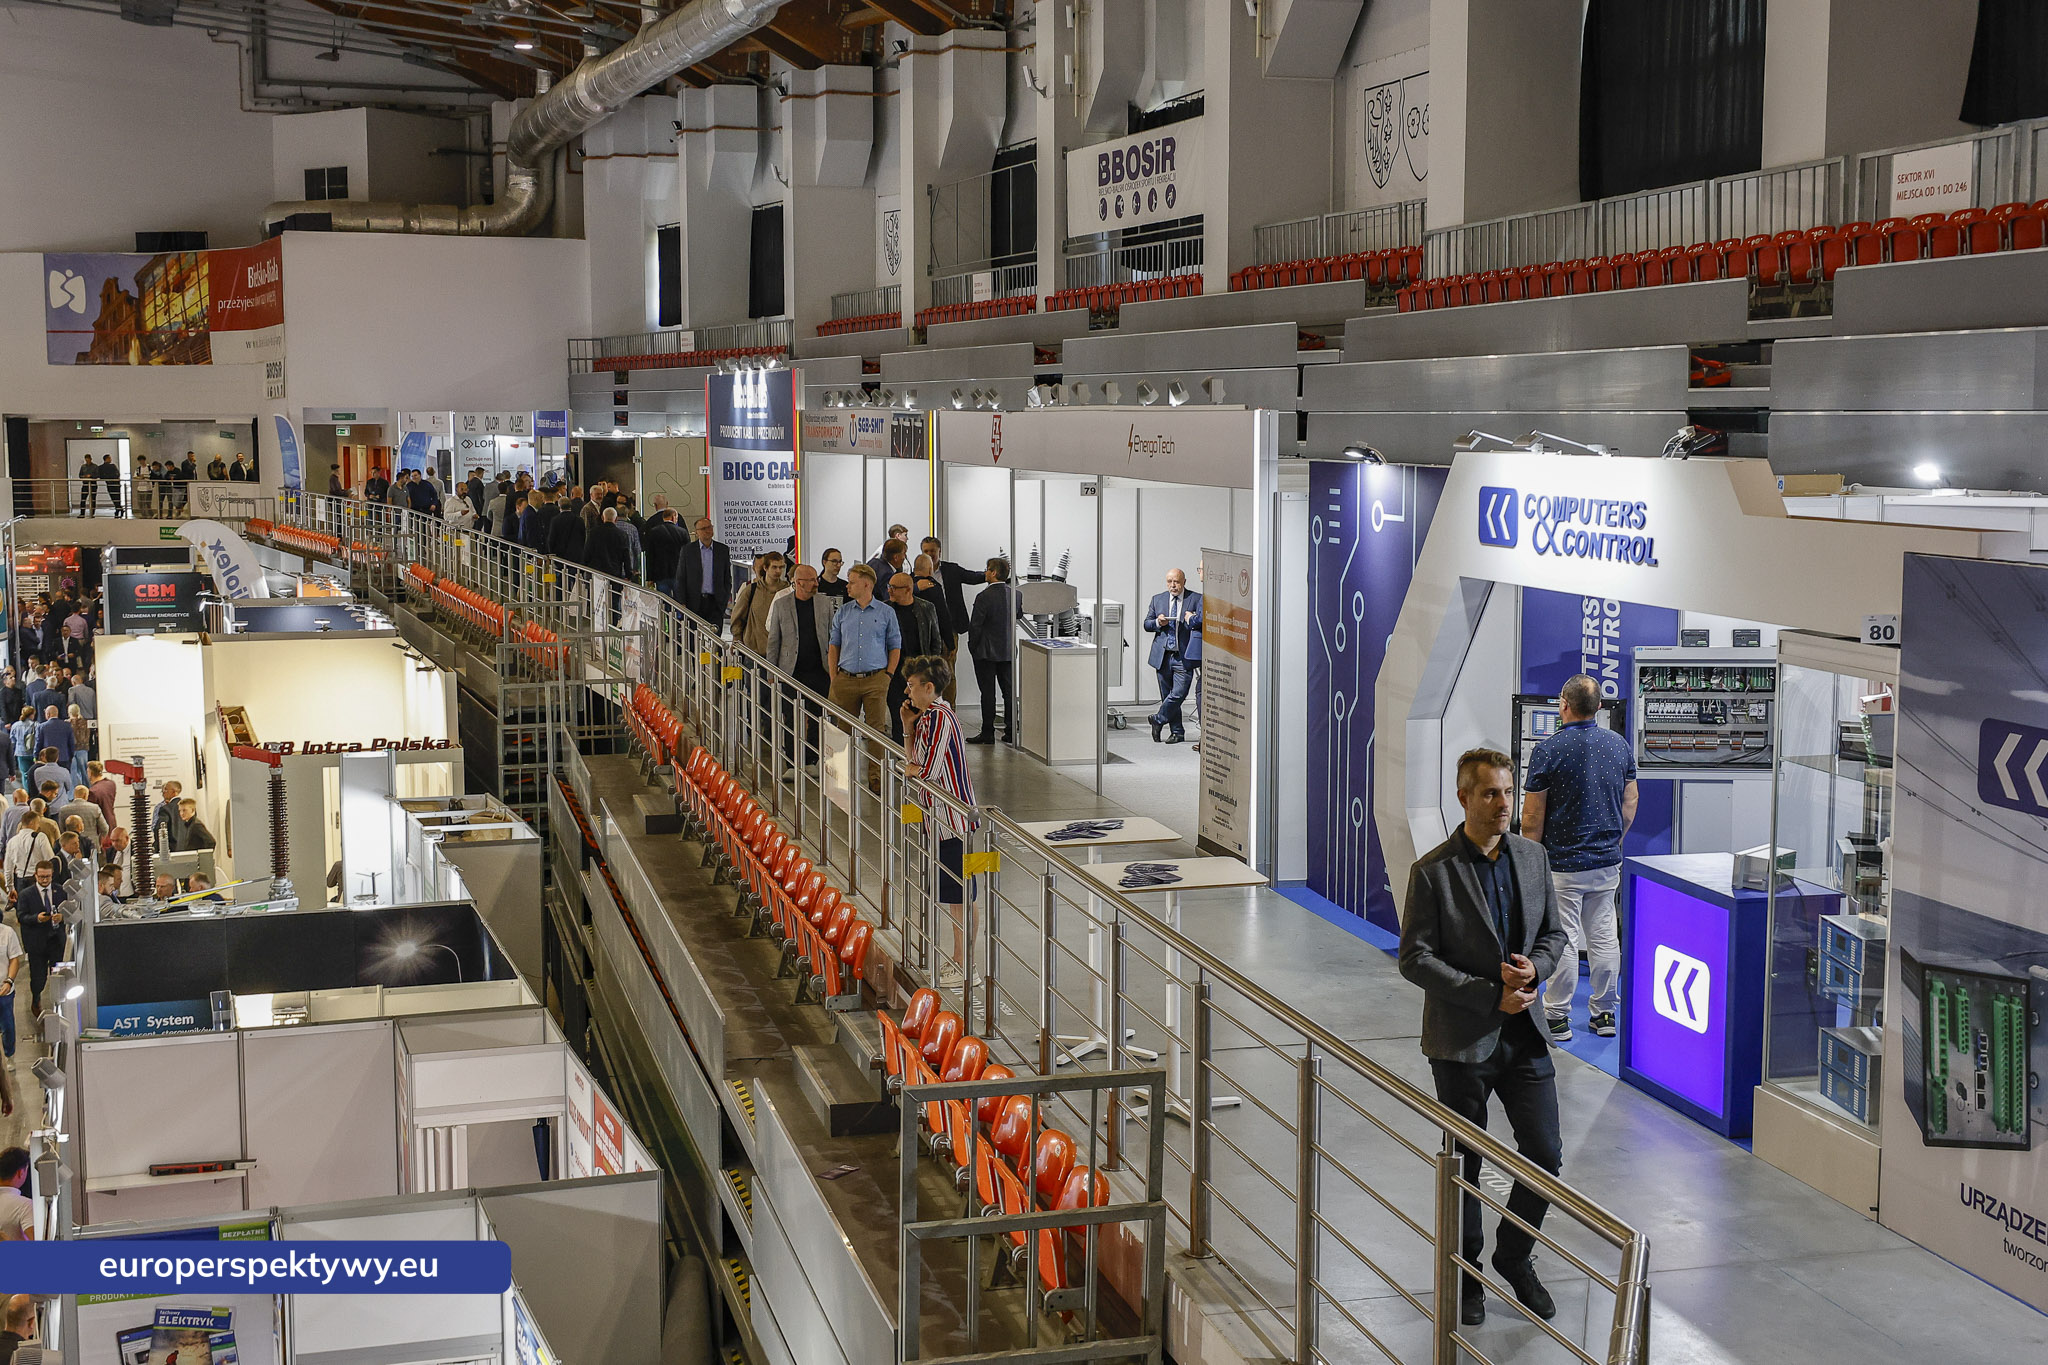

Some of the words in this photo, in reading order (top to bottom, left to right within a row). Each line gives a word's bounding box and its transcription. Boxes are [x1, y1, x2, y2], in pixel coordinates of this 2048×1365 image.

[1098, 136, 1176, 187] BBOSiR
[1897, 171, 1922, 184] SEKTOR
[1923, 169, 1935, 180] XVI
[1896, 188, 1923, 201] MIEJSCA
[1924, 186, 1935, 197] OD
[1937, 186, 1941, 195] 1
[1943, 184, 1953, 194] DO
[1955, 182, 1968, 193] 246
[805, 425, 845, 439] TRANSFORMATORY
[858, 416, 885, 434] SGB-SMIT
[722, 461, 765, 481] BICC
[1084, 486, 1097, 495] 79
[1524, 493, 1648, 530] COMPUTERS
[1562, 528, 1659, 567] CONTROL
[134, 583, 177, 598] CBM
[1581, 597, 1601, 678] TERS
[1869, 625, 1895, 640] 80
[302, 741, 363, 755] Intra
[371, 737, 450, 752] Polska
[113, 1016, 141, 1030] AST
[147, 1014, 195, 1028] System
[1960, 1182, 2048, 1247] URZĄDZE
[222, 1228, 266, 1239] BEZPŁATNE
[157, 1315, 215, 1327] ELEKTRYK
[159, 1309, 180, 1318] fachowy
